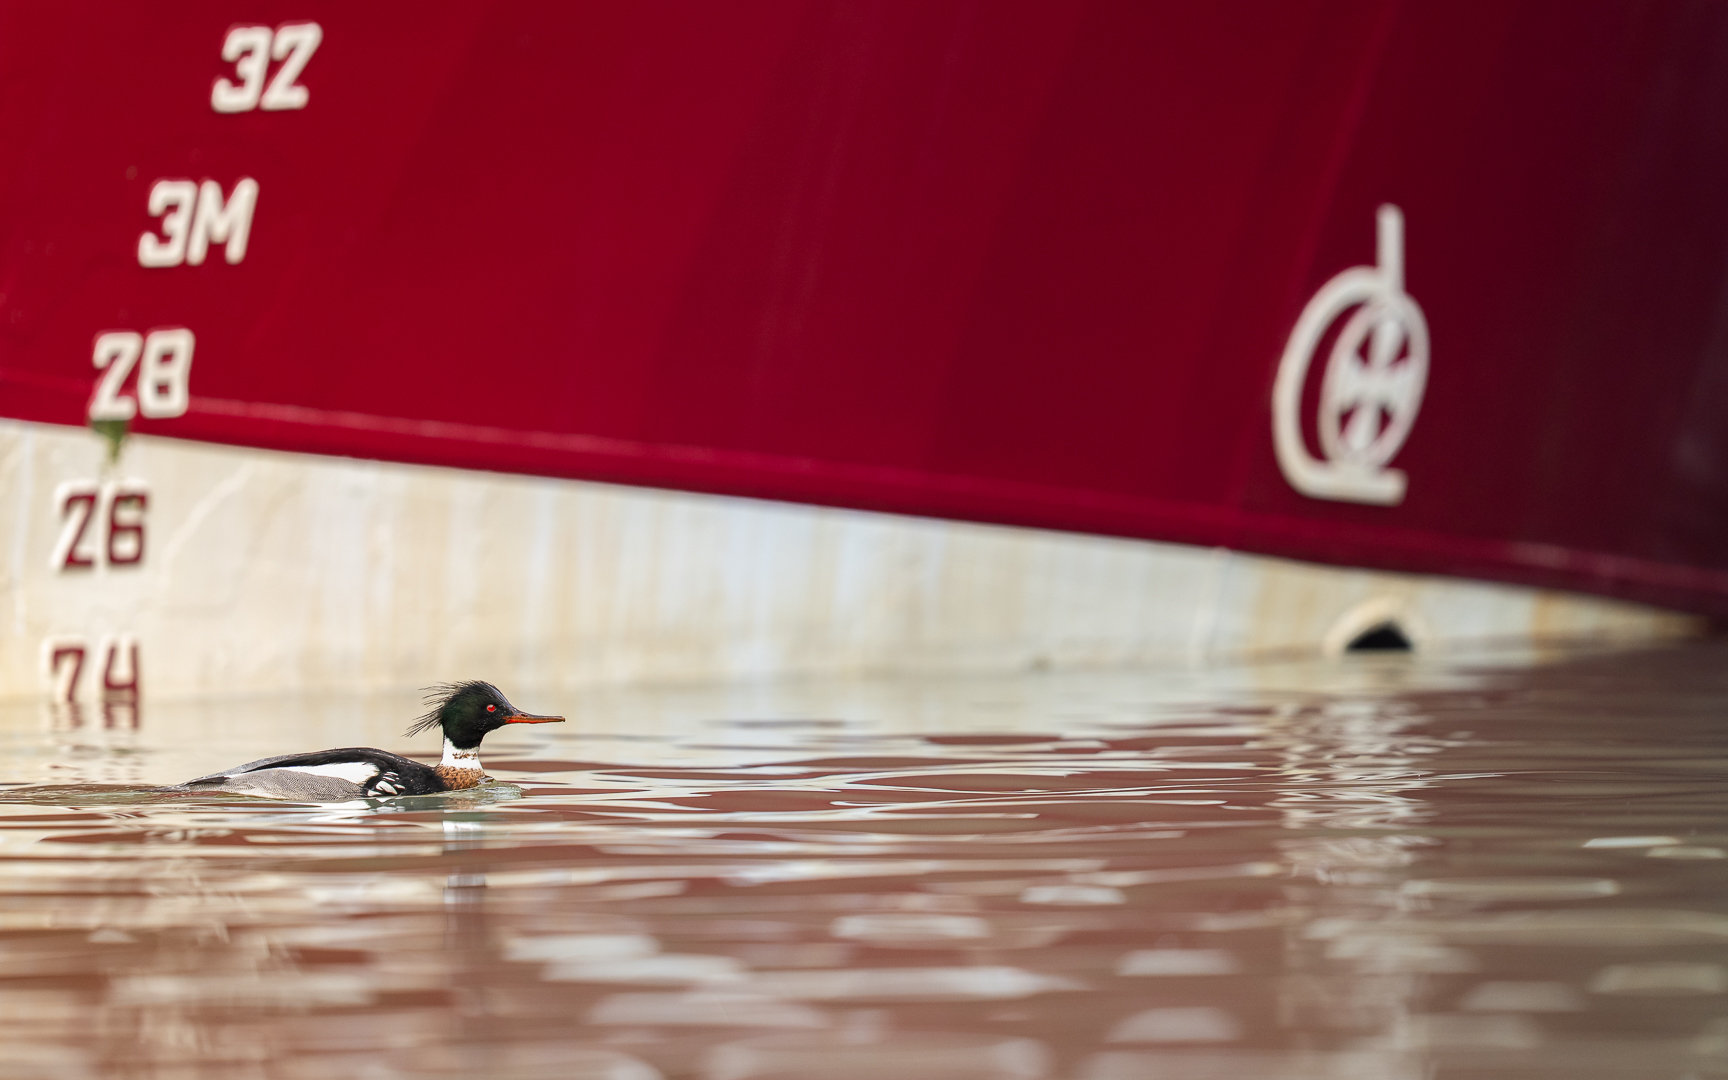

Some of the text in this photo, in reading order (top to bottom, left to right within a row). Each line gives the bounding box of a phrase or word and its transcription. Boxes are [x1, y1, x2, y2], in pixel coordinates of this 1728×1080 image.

[211, 22, 323, 113] 32
[138, 177, 259, 268] 3M
[89, 328, 196, 420] 28
[57, 490, 149, 570] 26
